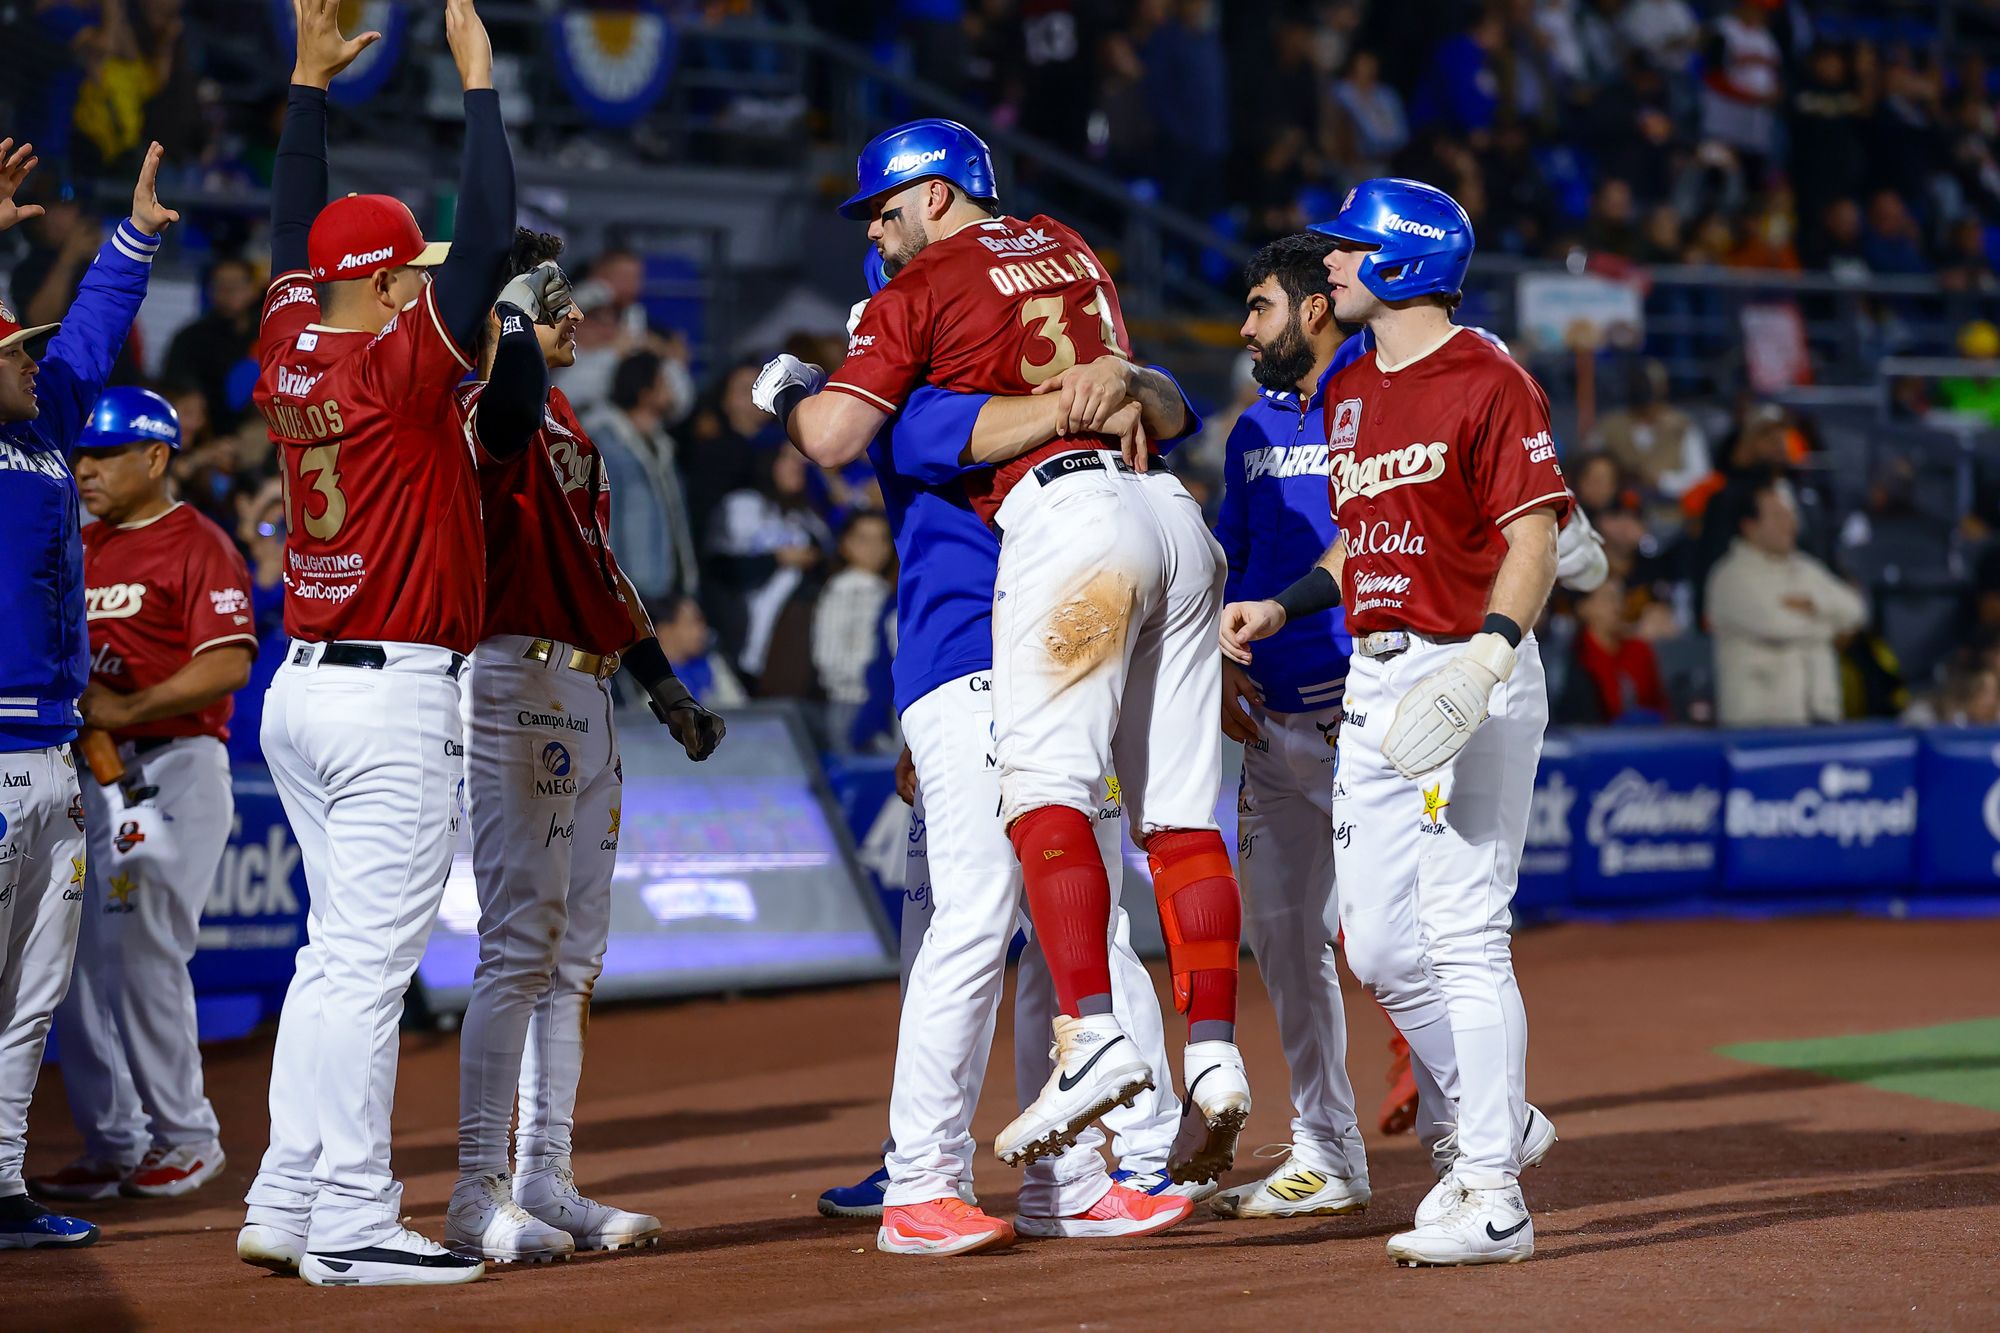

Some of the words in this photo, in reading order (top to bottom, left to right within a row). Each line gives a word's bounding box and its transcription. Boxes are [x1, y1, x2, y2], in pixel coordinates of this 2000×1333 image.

[1377, 213, 1446, 241] AKRON
[336, 246, 394, 271] AKRON
[988, 251, 1100, 297] ORNELAS
[1020, 285, 1129, 386] 31
[265, 397, 345, 440] AÑUELOS
[1062, 455, 1105, 470] Orne
[1530, 445, 1556, 464] GEL
[1329, 441, 1448, 514] Charros
[279, 442, 347, 542] 13
[1368, 519, 1426, 556] Cola
[294, 578, 362, 605] BanCoppe
[517, 711, 564, 730] Campo
[566, 713, 589, 734] Azul
[3, 771, 32, 788] Azul
[536, 779, 578, 796] MEGA
